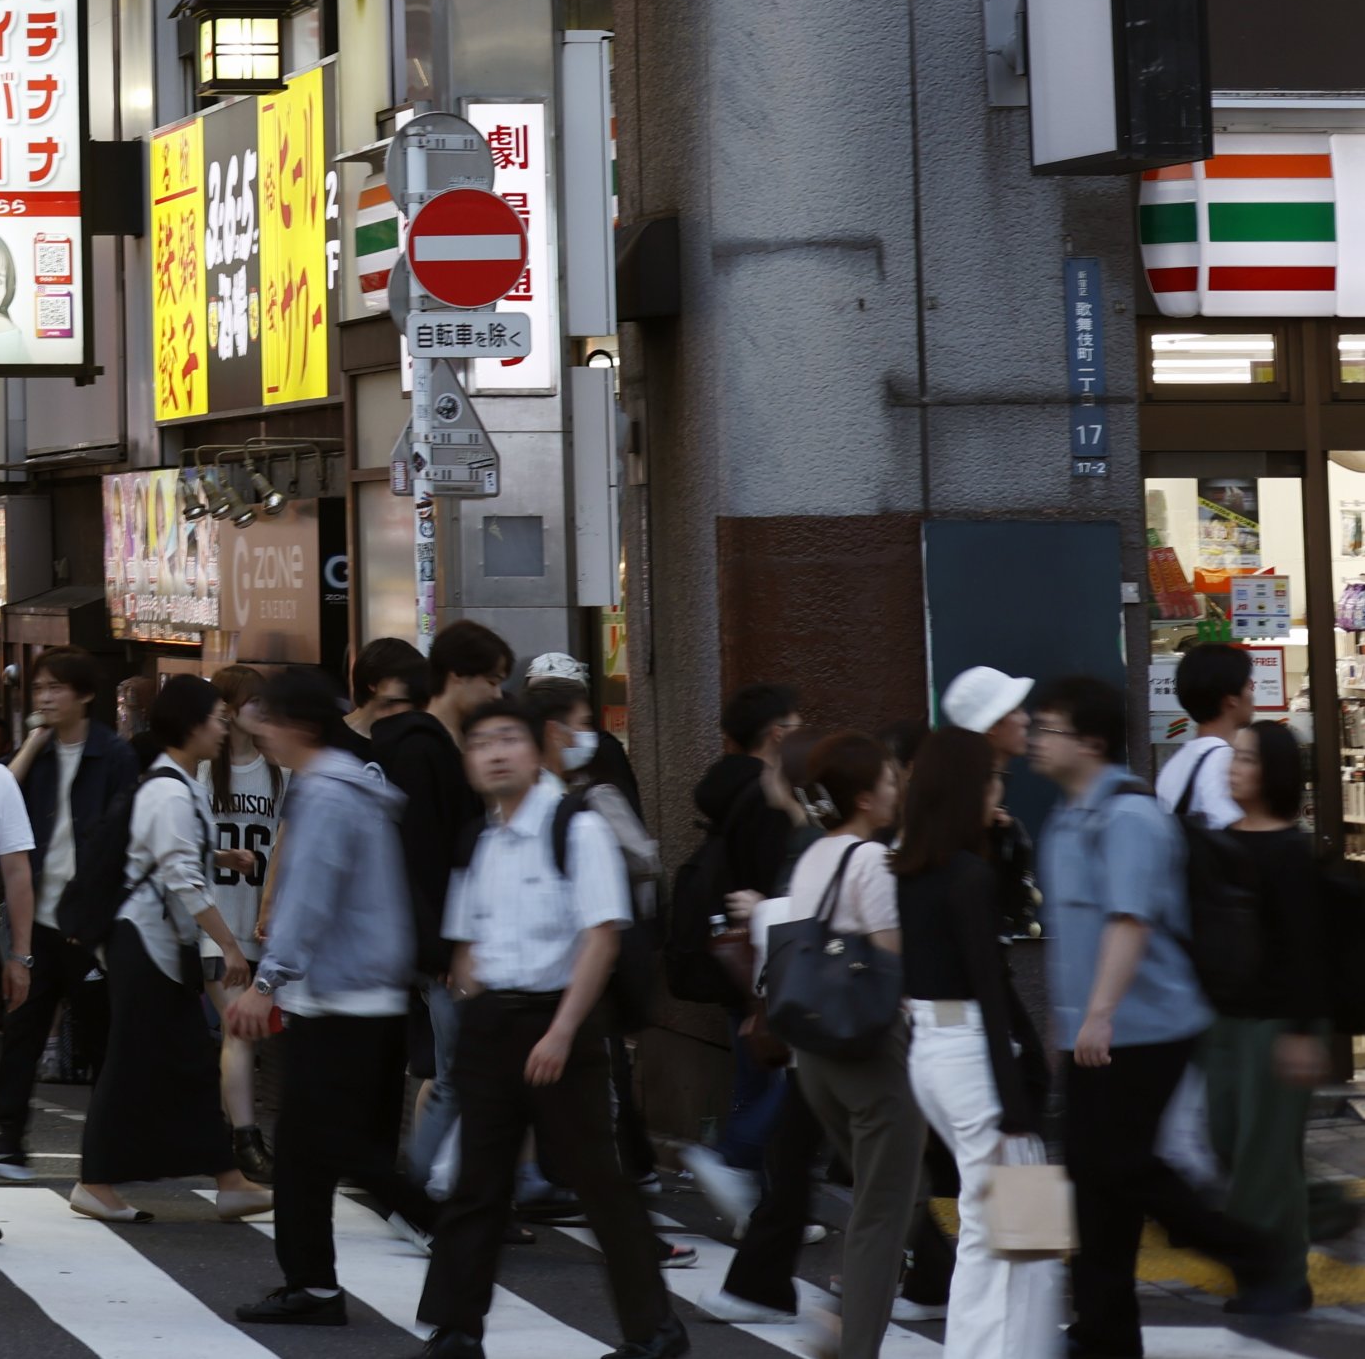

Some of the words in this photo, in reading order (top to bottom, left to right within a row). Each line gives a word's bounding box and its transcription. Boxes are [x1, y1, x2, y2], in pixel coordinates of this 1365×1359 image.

[278, 98, 320, 231] ビール
[323, 168, 341, 291] 2F
[1077, 270, 1089, 296] 新宿区
[157, 312, 201, 412] 餃子
[416, 322, 522, 349] 自転車を除く
[1074, 301, 1097, 407] 歌舞伎町一丁目
[1075, 424, 1103, 445] 17
[1076, 462, 1106, 474] 17-2
